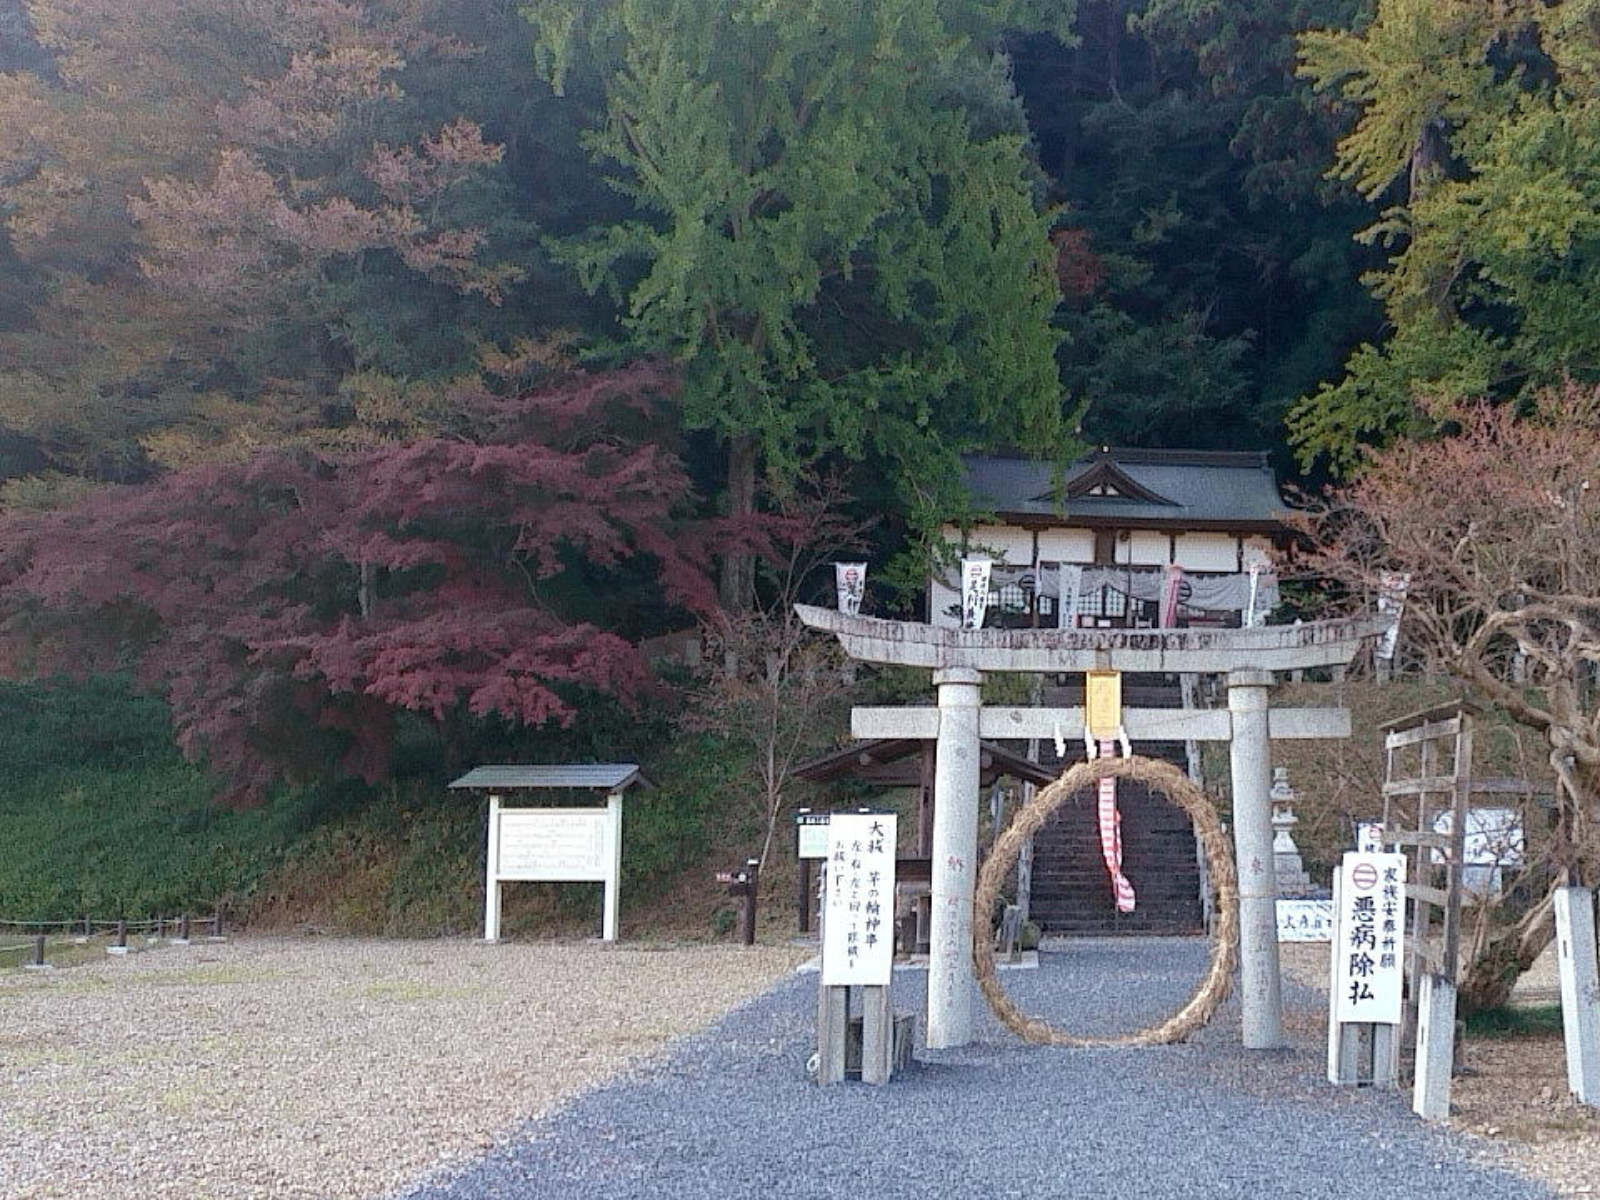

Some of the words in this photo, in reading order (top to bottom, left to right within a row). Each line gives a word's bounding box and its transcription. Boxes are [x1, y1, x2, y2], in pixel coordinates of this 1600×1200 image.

[1348, 896, 1377, 1005] 悪病除払
[1380, 866, 1398, 969] 家族安泰祈願
